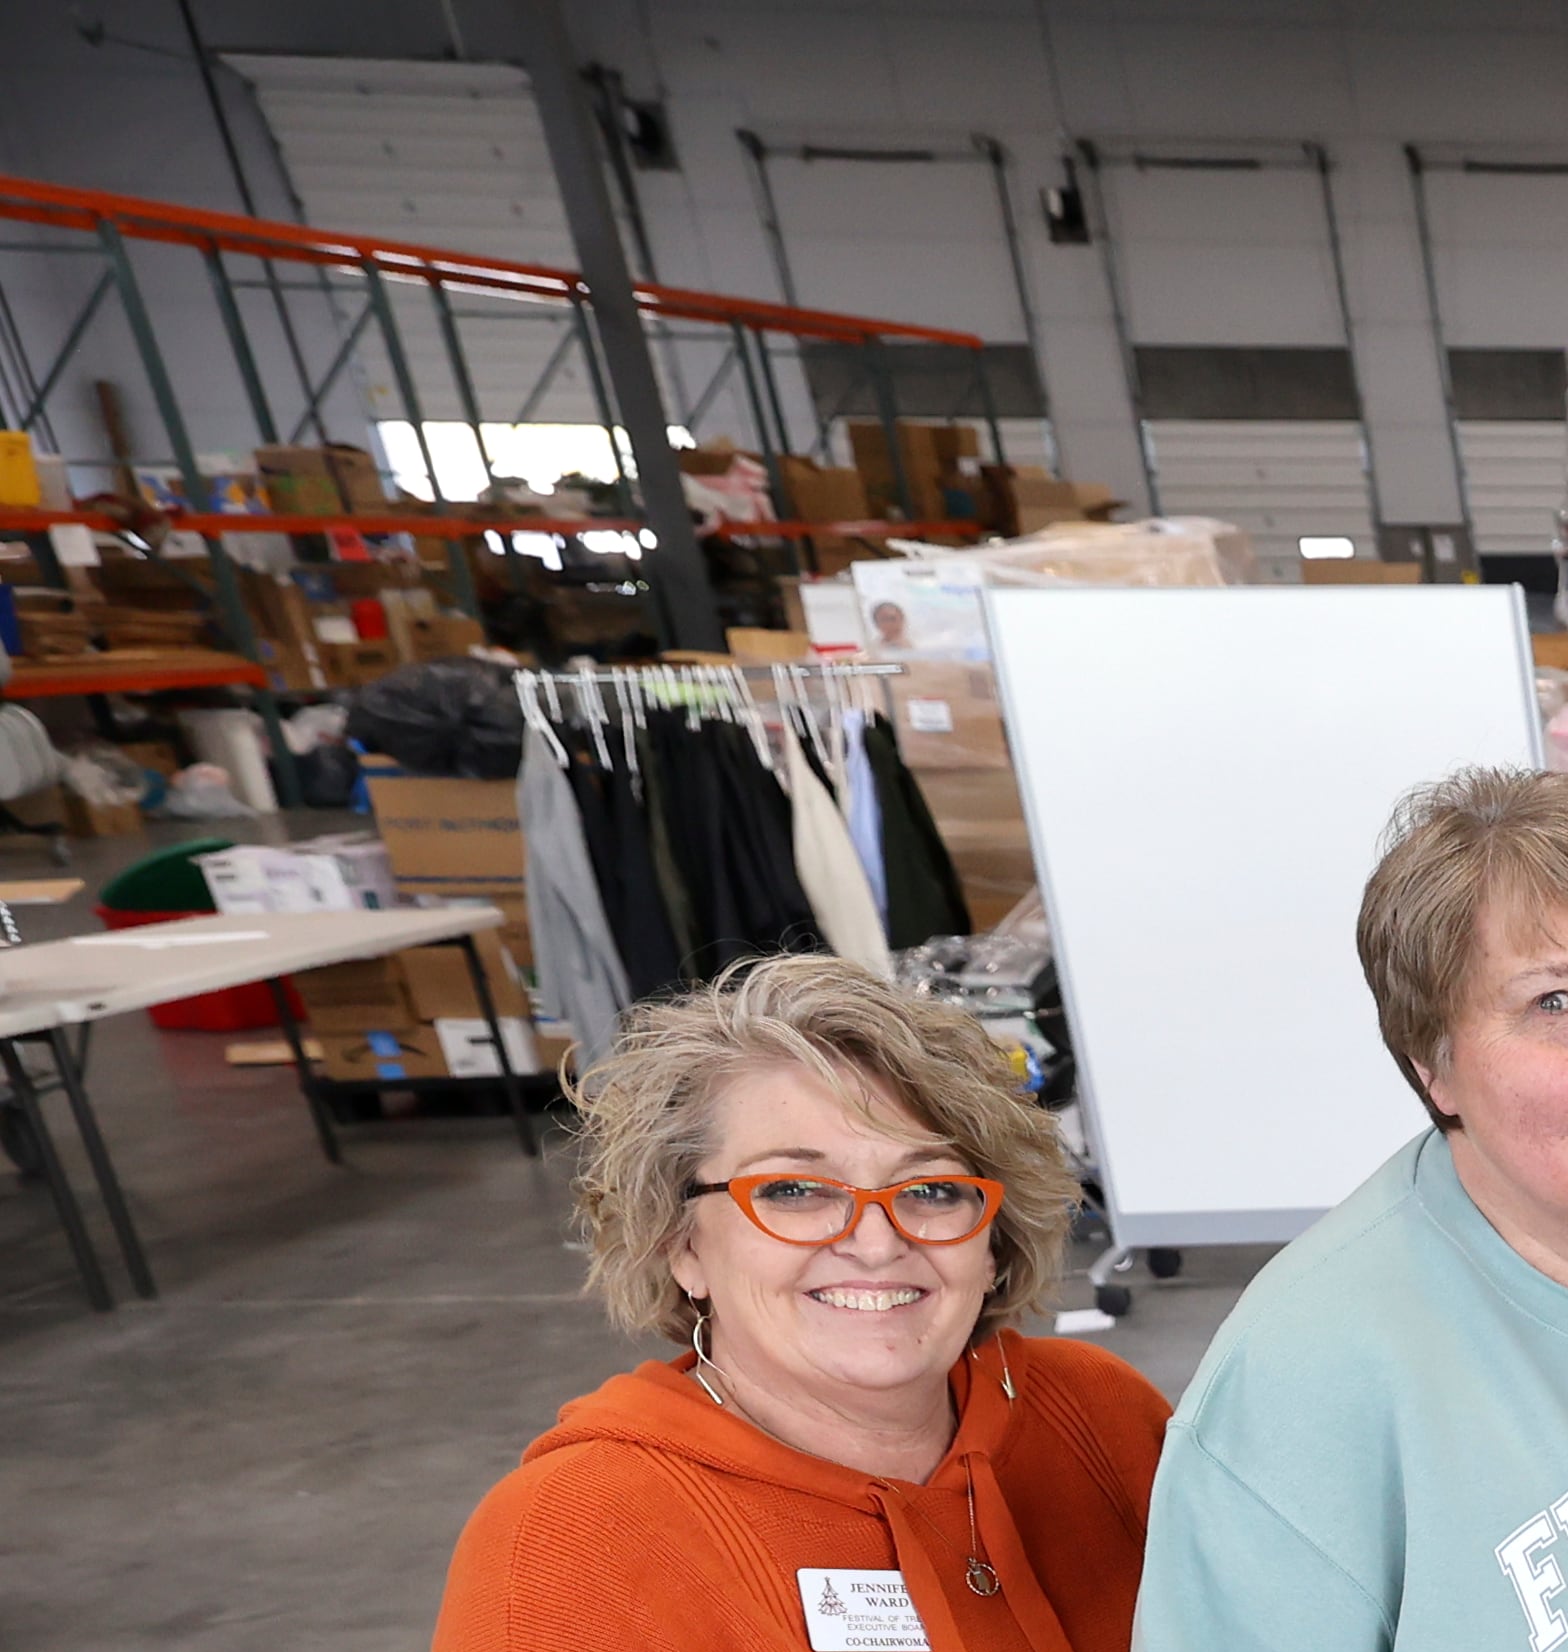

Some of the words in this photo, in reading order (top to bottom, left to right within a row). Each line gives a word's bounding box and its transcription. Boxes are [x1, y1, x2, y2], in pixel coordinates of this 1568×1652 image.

[850, 1583, 908, 1593] JENNIFE
[866, 1597, 909, 1608] WARD
[842, 1614, 884, 1623] FESTIVAL
[888, 1615, 899, 1623] OF
[904, 1615, 923, 1623] TRE
[847, 1623, 898, 1632] EXECUTIVE
[902, 1624, 925, 1632] BOA
[846, 1637, 930, 1647] CO-CHAIRWOMA
